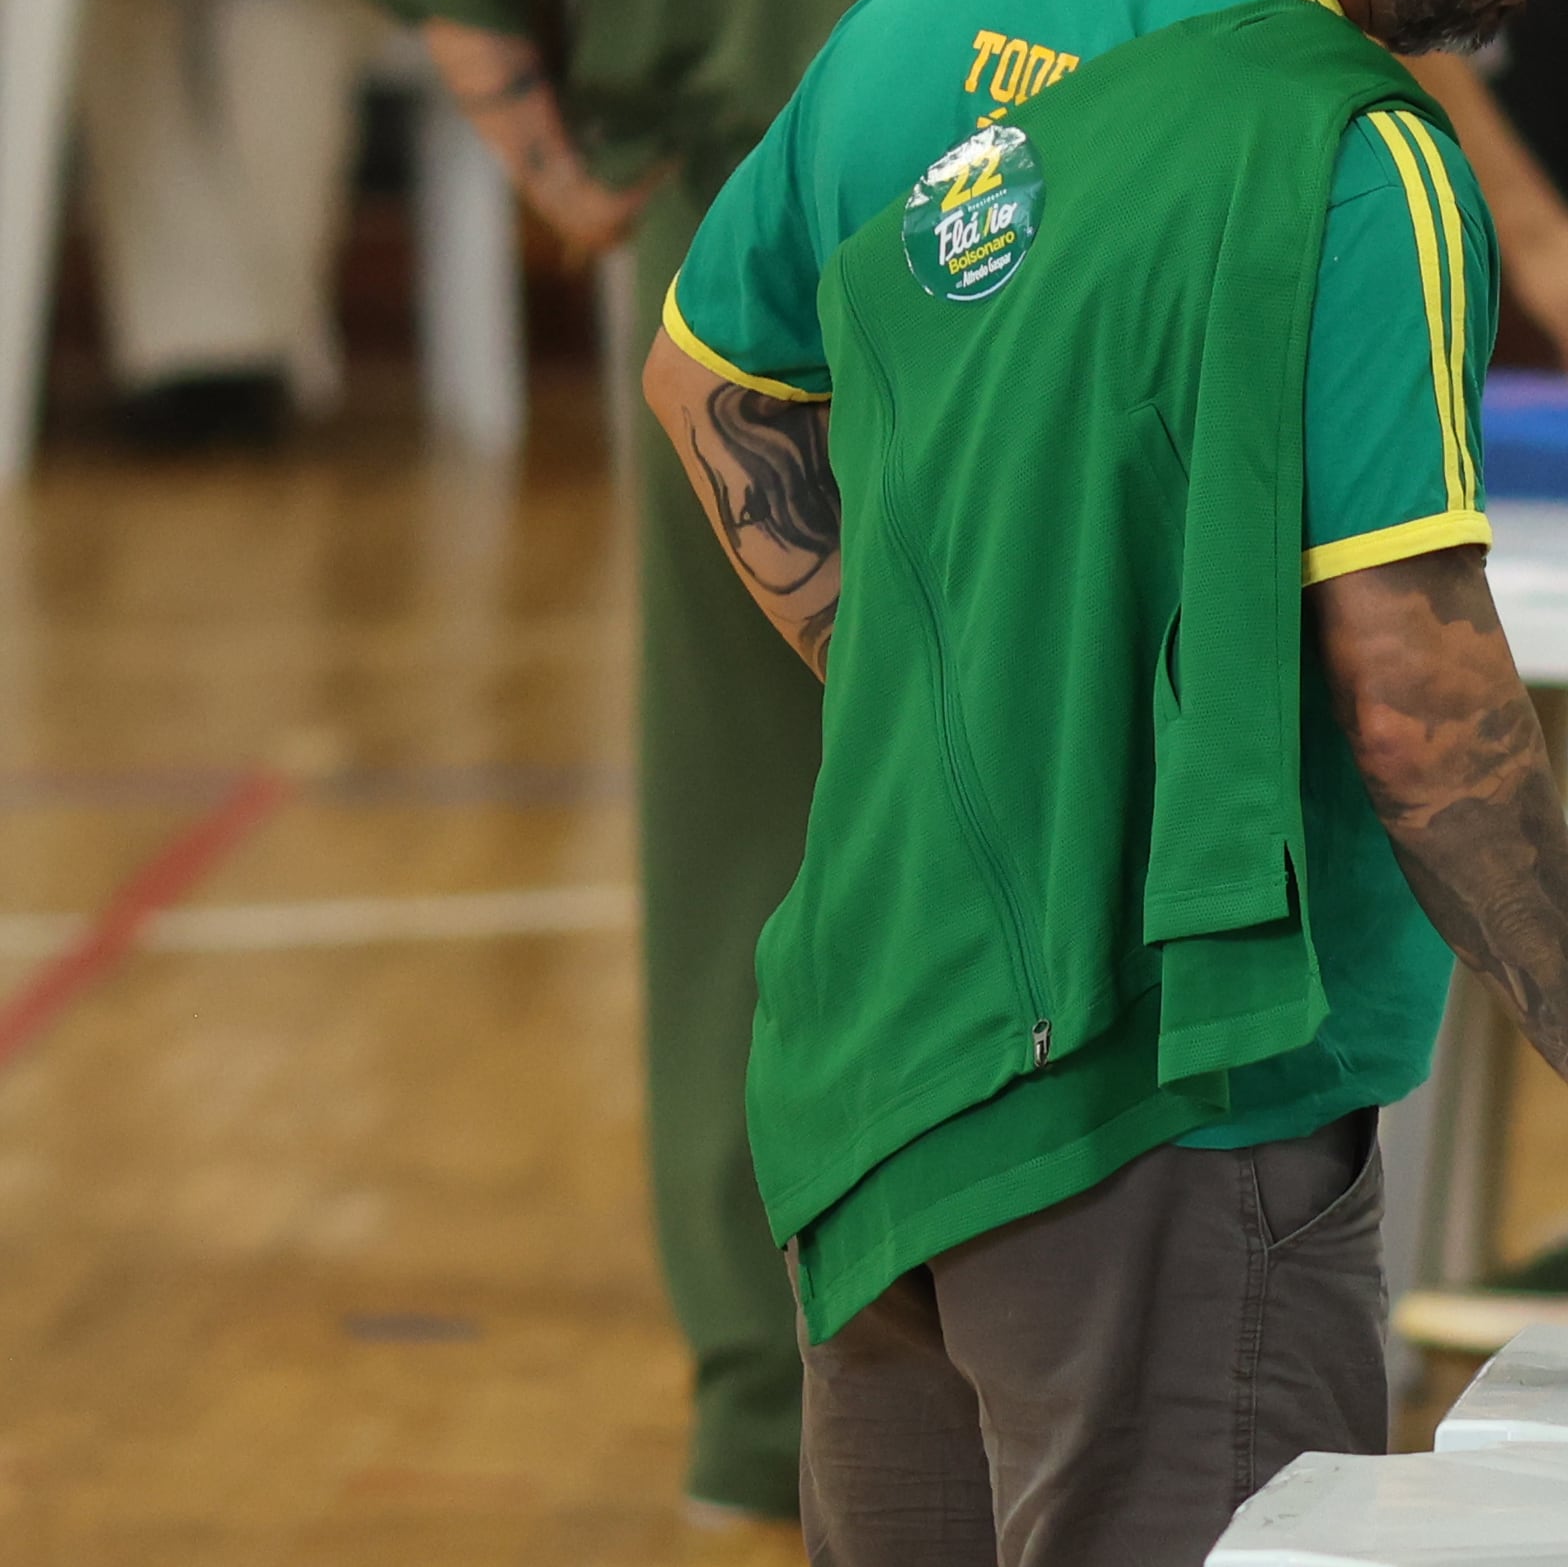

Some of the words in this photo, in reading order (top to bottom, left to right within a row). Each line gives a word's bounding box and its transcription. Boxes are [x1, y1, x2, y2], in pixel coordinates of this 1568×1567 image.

[940, 142, 1003, 213] 22
[948, 231, 1016, 275] Bolsonaro
[962, 263, 988, 288] Alfredo
[987, 251, 1012, 273] Gaspar
